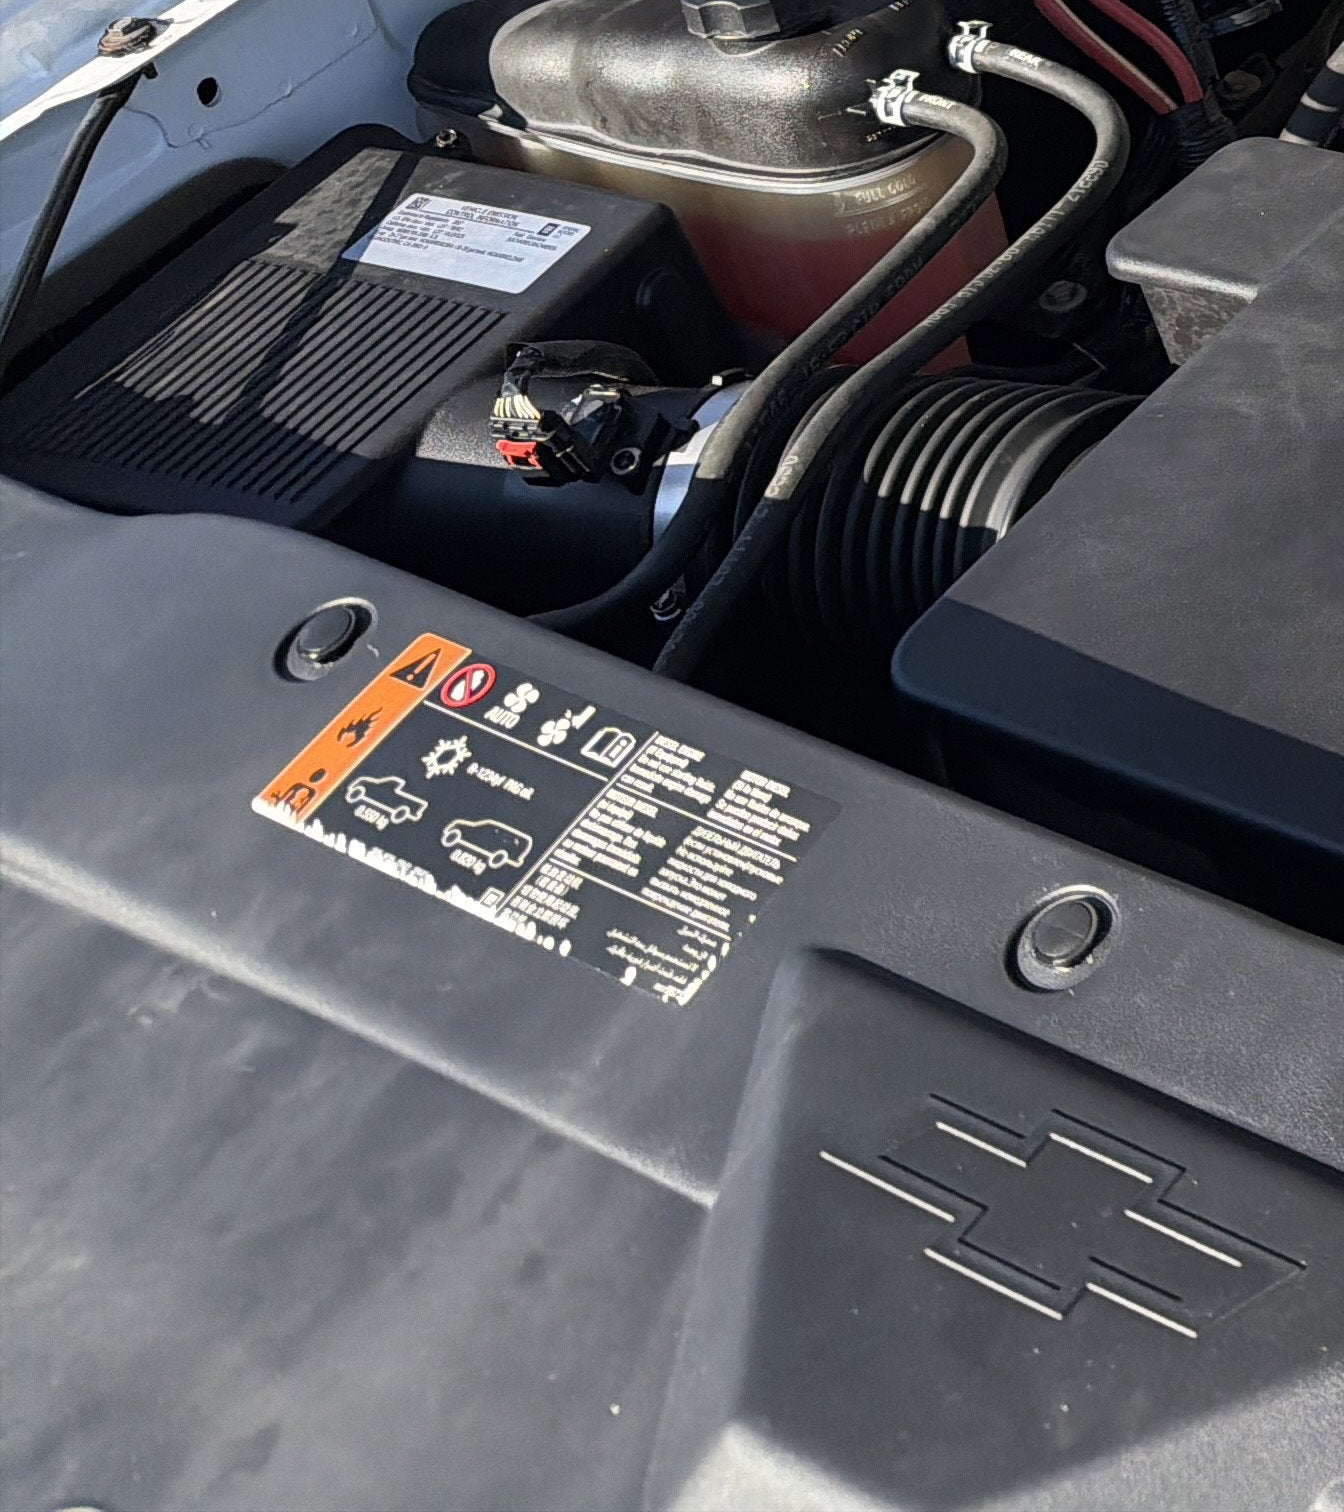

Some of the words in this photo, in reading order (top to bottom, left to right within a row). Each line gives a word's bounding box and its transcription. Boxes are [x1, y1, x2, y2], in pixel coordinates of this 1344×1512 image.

[1009, 49, 1042, 69] REAR
[918, 94, 958, 110] FRONT
[483, 705, 521, 729] AUTO
